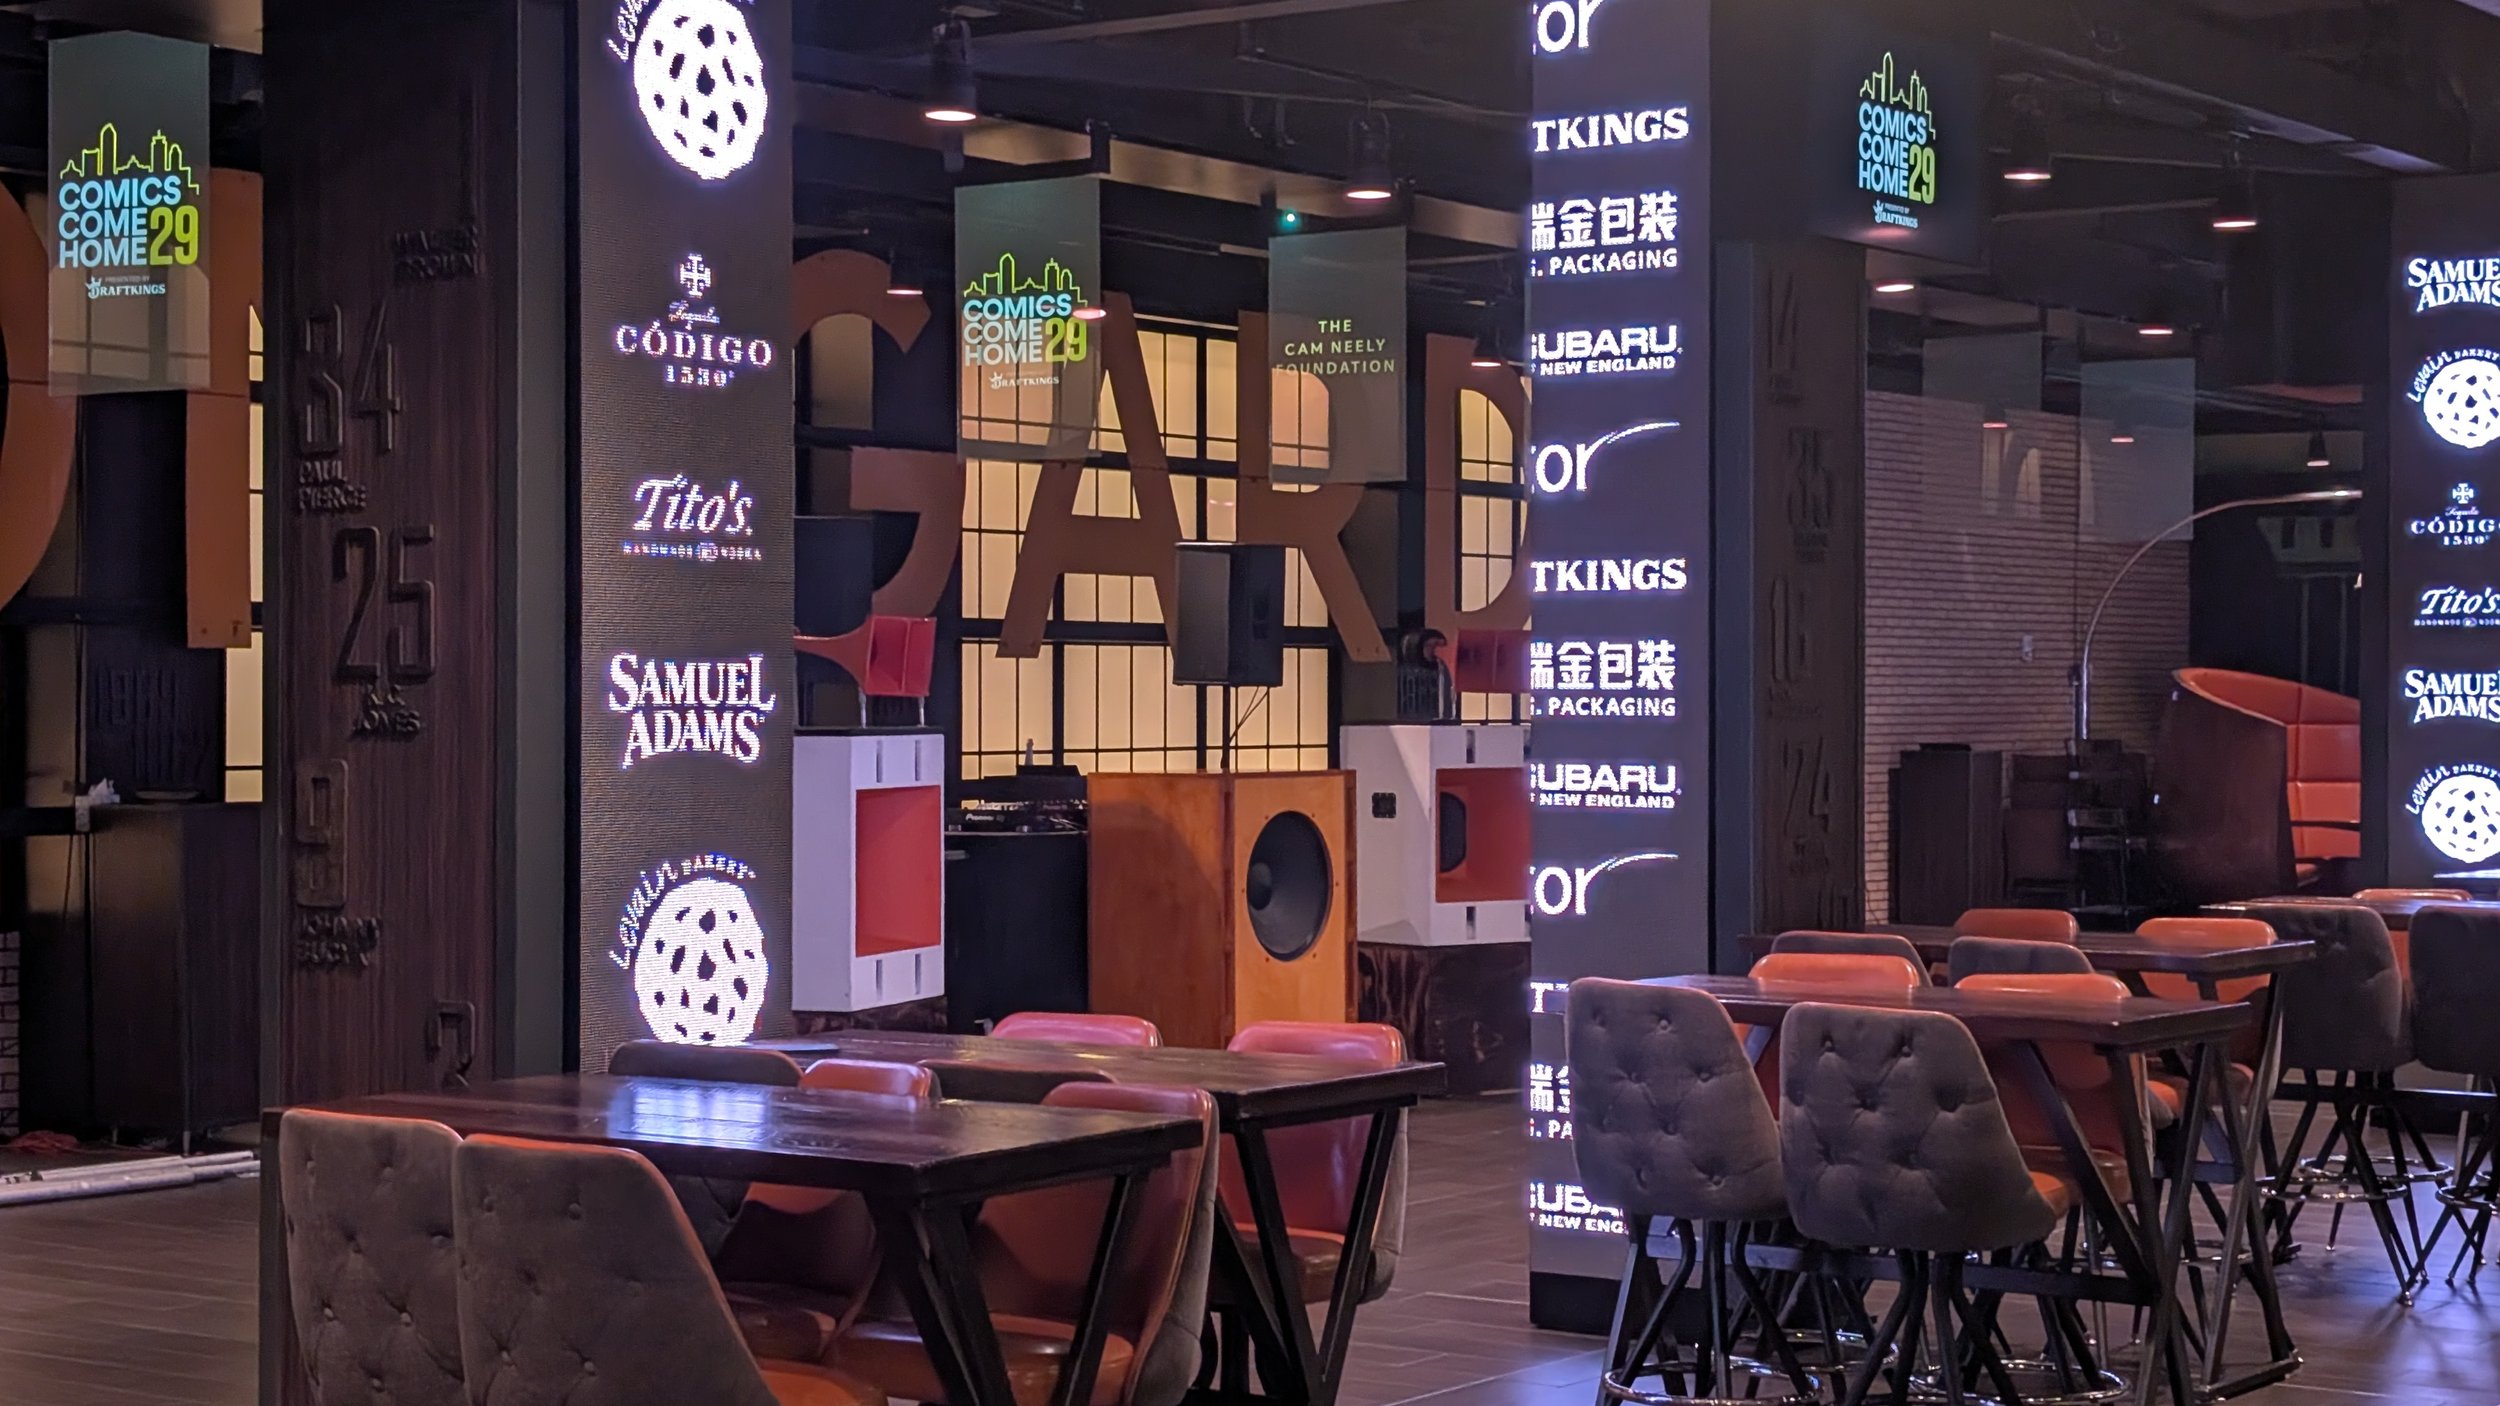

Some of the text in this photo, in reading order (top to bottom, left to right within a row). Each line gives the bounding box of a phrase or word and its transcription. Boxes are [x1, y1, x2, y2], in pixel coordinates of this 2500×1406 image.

[1532, 0, 1600, 53] or
[1532, 107, 1689, 152] TKINGS
[1859, 101, 1927, 145] COMICS
[1858, 131, 1909, 169] COME
[1858, 159, 1909, 198] HOME
[1909, 144, 1935, 204] 29
[59, 175, 182, 211] COMICS
[58, 207, 148, 240] COME
[150, 205, 199, 266] 29
[59, 236, 147, 269] HOME
[1550, 248, 1677, 275] PACKAGING
[87, 283, 166, 299] DRAFTKINGS
[963, 293, 1072, 322] COMICS
[964, 319, 1043, 344] COME
[1045, 317, 1087, 363] 29
[1318, 319, 1352, 334] THE
[616, 320, 772, 367] CÓDIGO
[964, 341, 1043, 367] HOME
[1285, 338, 1386, 356] CAM NEELY
[1276, 359, 1395, 376] FOUNDATION
[1540, 356, 1676, 376] NEW ENGLAND
[2406, 349, 2499, 402] Levain BAKERY
[632, 473, 752, 533] Tito's
[2411, 516, 2500, 534] CÓDIG
[1531, 558, 1687, 592] TKINGS
[332, 524, 435, 685] 25
[2421, 586, 2500, 614] Tito's
[609, 652, 776, 712] SAMUEL
[2405, 670, 2500, 699] SAMUE
[1548, 697, 1675, 716] PACKAGING
[2413, 696, 2500, 723] ADAMS
[623, 709, 760, 769] ADAMS
[1540, 793, 1675, 808] NEW ENGLAND
[2405, 764, 2497, 815] Levain BAKERY
[608, 861, 678, 970] Levain
[1539, 1213, 1581, 1229] NEW
